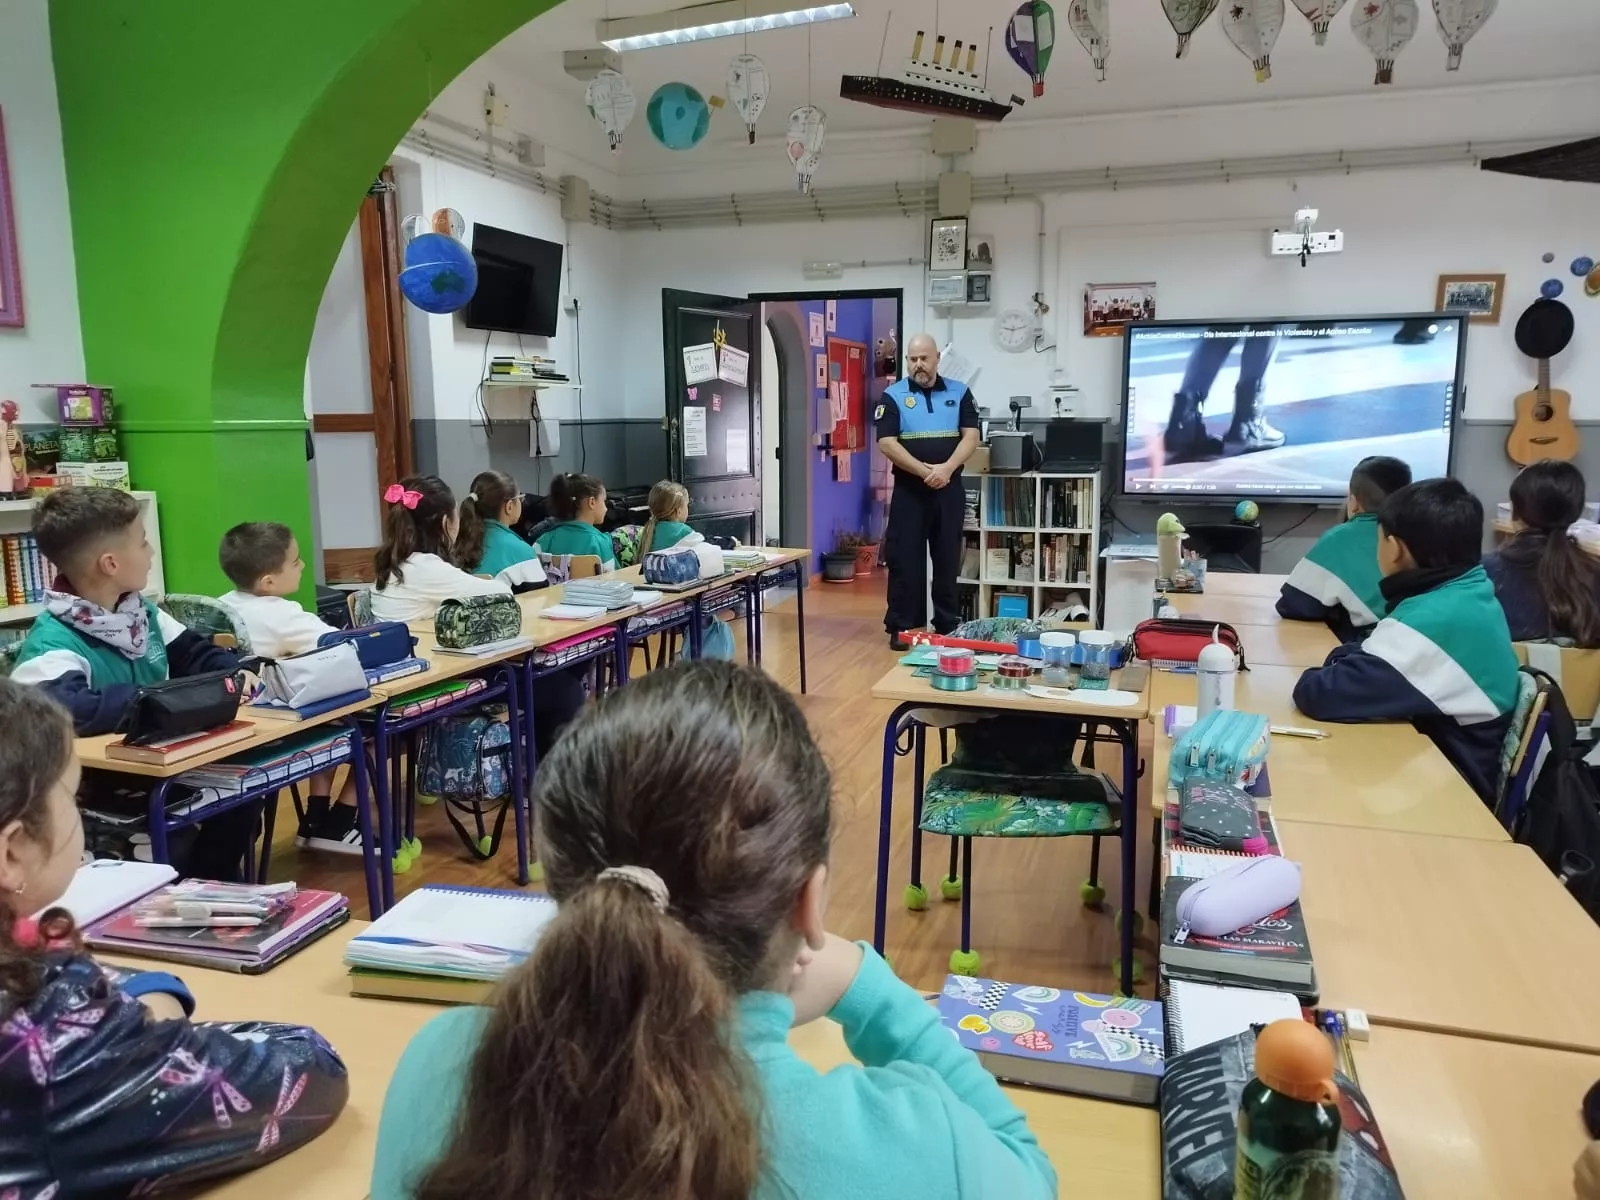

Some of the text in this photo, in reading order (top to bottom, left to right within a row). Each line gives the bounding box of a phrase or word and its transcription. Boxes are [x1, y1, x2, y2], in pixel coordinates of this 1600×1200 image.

[1215, 330, 1255, 338] Internacional
[1255, 329, 1275, 337] contra
[1283, 328, 1312, 336] Violencia
[25, 441, 59, 452] PLANETA
[1242, 936, 1305, 948] MARAVILLAS
[1064, 1005, 1080, 1038] POSITIVE
[1161, 1042, 1237, 1186] MARVEL
